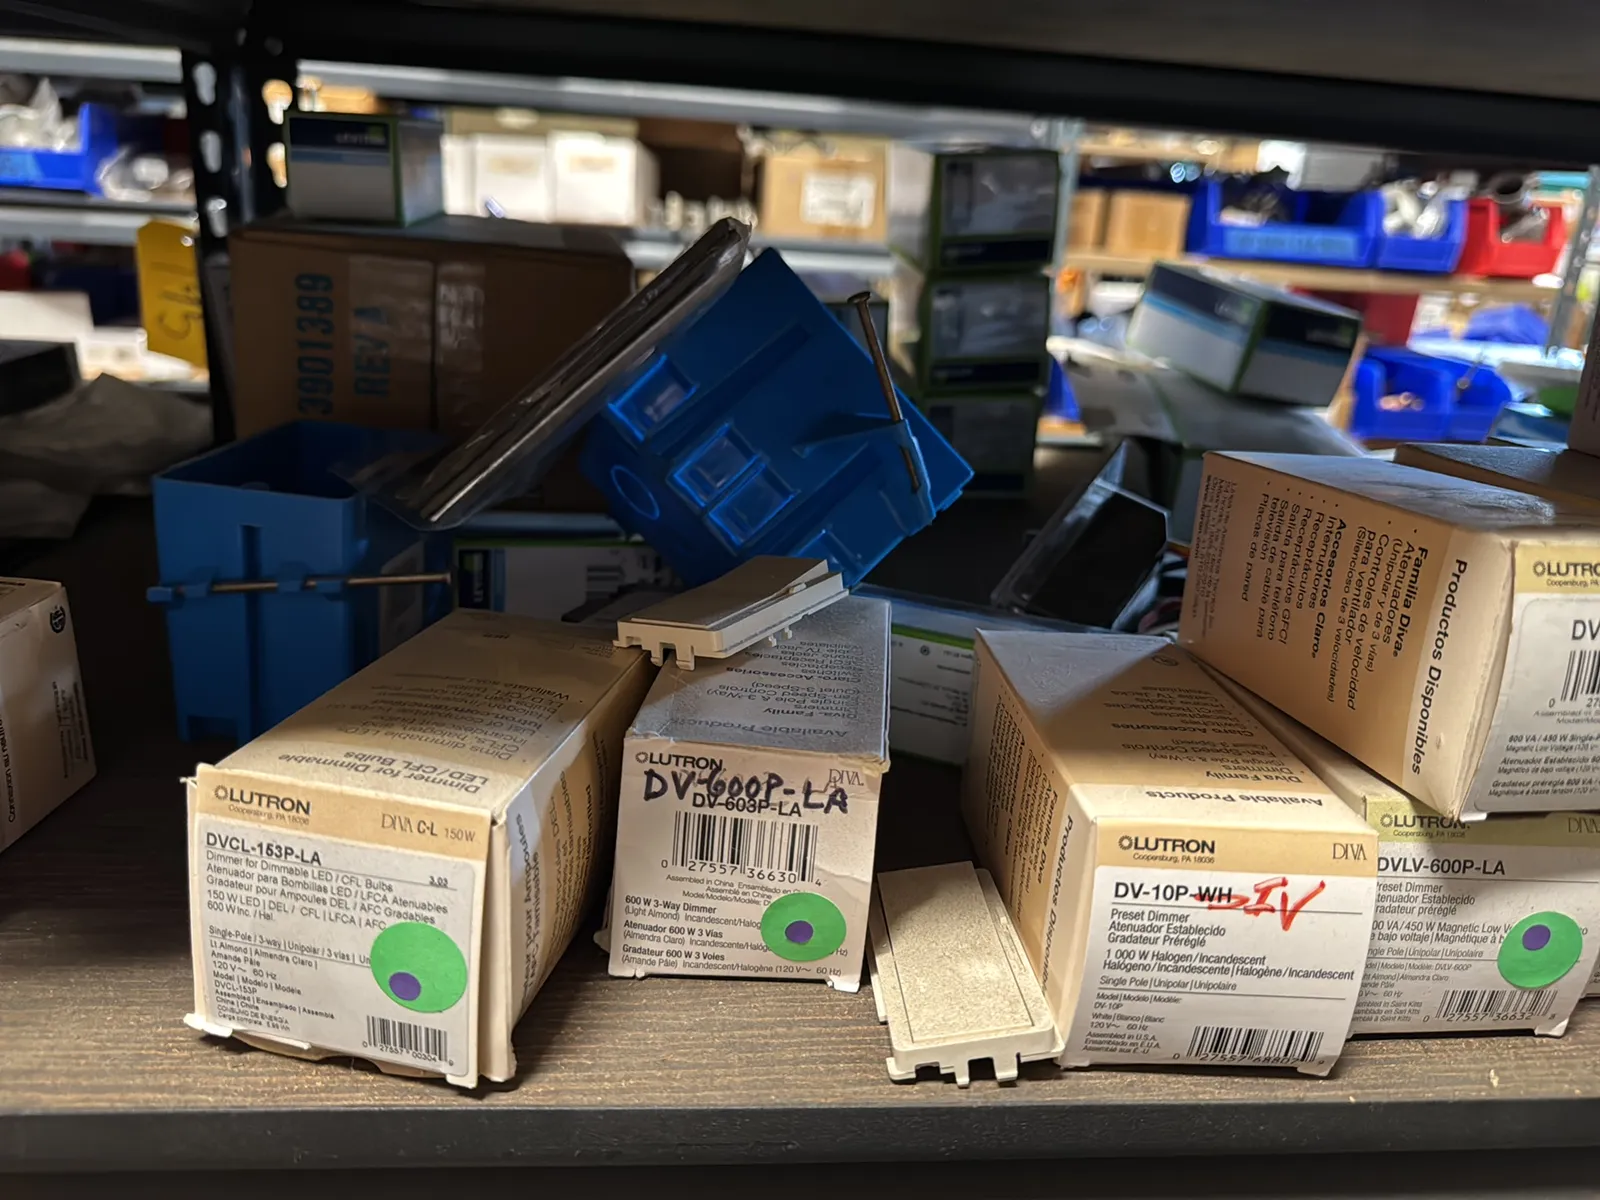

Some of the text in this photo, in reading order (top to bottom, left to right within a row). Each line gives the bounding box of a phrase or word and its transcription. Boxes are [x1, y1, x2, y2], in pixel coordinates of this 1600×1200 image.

[295, 273, 335, 415] 3901389
[1283, 503, 1300, 547] Salida
[1241, 493, 1269, 602] Placas de pared
[1256, 499, 1288, 638] Salida cable para
[1295, 511, 1325, 610] Receptáculos
[1308, 515, 1338, 610] Interruptores
[1319, 518, 1347, 608] Accesorios
[1381, 538, 1403, 598] (Unipolar
[1278, 507, 1312, 645] Receptáculos GFCI
[1403, 546, 1429, 610] Familia
[1344, 529, 1377, 645] para ventilador
[1382, 541, 1415, 644] Atenuadores
[1327, 526, 1367, 703] (Silencioso velocidades)
[1347, 534, 1390, 711] Controles de velocidad
[1411, 558, 1468, 776] Productos Disponibles
[384, 732, 466, 750] dimmable
[344, 751, 396, 767] Bulbs
[649, 752, 723, 771] LUTRON
[278, 752, 481, 794] Dimmer for Dimmable
[829, 769, 862, 787] DIVA
[1206, 770, 1261, 781] Family
[1223, 764, 1293, 775] Dimmers
[229, 788, 311, 816] LUTRON
[692, 792, 802, 817] DV-603P-LA
[1146, 790, 1324, 807] Available Products
[381, 813, 413, 833] DIVA
[1394, 814, 1467, 830] LUTRON
[206, 832, 322, 866] DVCL-153P-LA
[1134, 836, 1216, 854] LUTRON
[1332, 842, 1368, 861] DIVA
[515, 812, 534, 904] Ampoules
[1052, 814, 1074, 908] Productos
[1377, 856, 1505, 876] DVLV-600P-LA
[206, 850, 394, 893] Dimmer for Dimmable LED CFL Bulbs
[666, 874, 705, 886] Assembled
[688, 860, 797, 884] 27557 36630
[207, 863, 449, 915] Atenuador para Bombillas LED LFCA Atenuables
[1114, 881, 1233, 904] DV-10P-WH
[1405, 881, 1444, 894] Dimmer
[207, 875, 436, 925] Gradateur pour Ampoules DEL AFC Gradables
[207, 900, 224, 912] 600
[625, 895, 717, 915] 600 3-Way Dimmer
[1377, 893, 1476, 906] tenuador Establecido
[207, 889, 387, 931] 150 LED DEL CFL LFCA AFC
[624, 905, 681, 922] (Light Almond)
[1110, 907, 1190, 924] Preset Dimmer
[1375, 904, 1458, 918] radateur préréglé
[623, 930, 686, 946] (Almendra Claro)
[624, 920, 686, 936] Atenuador 600
[1108, 920, 1226, 937] Atenuador Establecido
[1377, 931, 1489, 945] bajo voltaje Magnétique
[1425, 921, 1502, 935] W Magnetic Low
[209, 925, 320, 956] Single-Pole 3-way Unipolar
[1107, 932, 1207, 949] Gradateur Préréglé
[220, 941, 313, 968] Almond Claro
[622, 944, 725, 962] Gradateur 600 Voies
[1138, 950, 1150, 961] W
[1408, 947, 1484, 959] Unipolar Unipolaire
[213, 961, 229, 971] 120
[621, 954, 842, 977] (Amande (120 Hz)
[1100, 975, 1237, 992] Single Unipolar Unipolaire
[1090, 1021, 1105, 1030] 120
[1446, 1013, 1489, 1023] 27557
[1200, 1053, 1247, 1063] 27557
